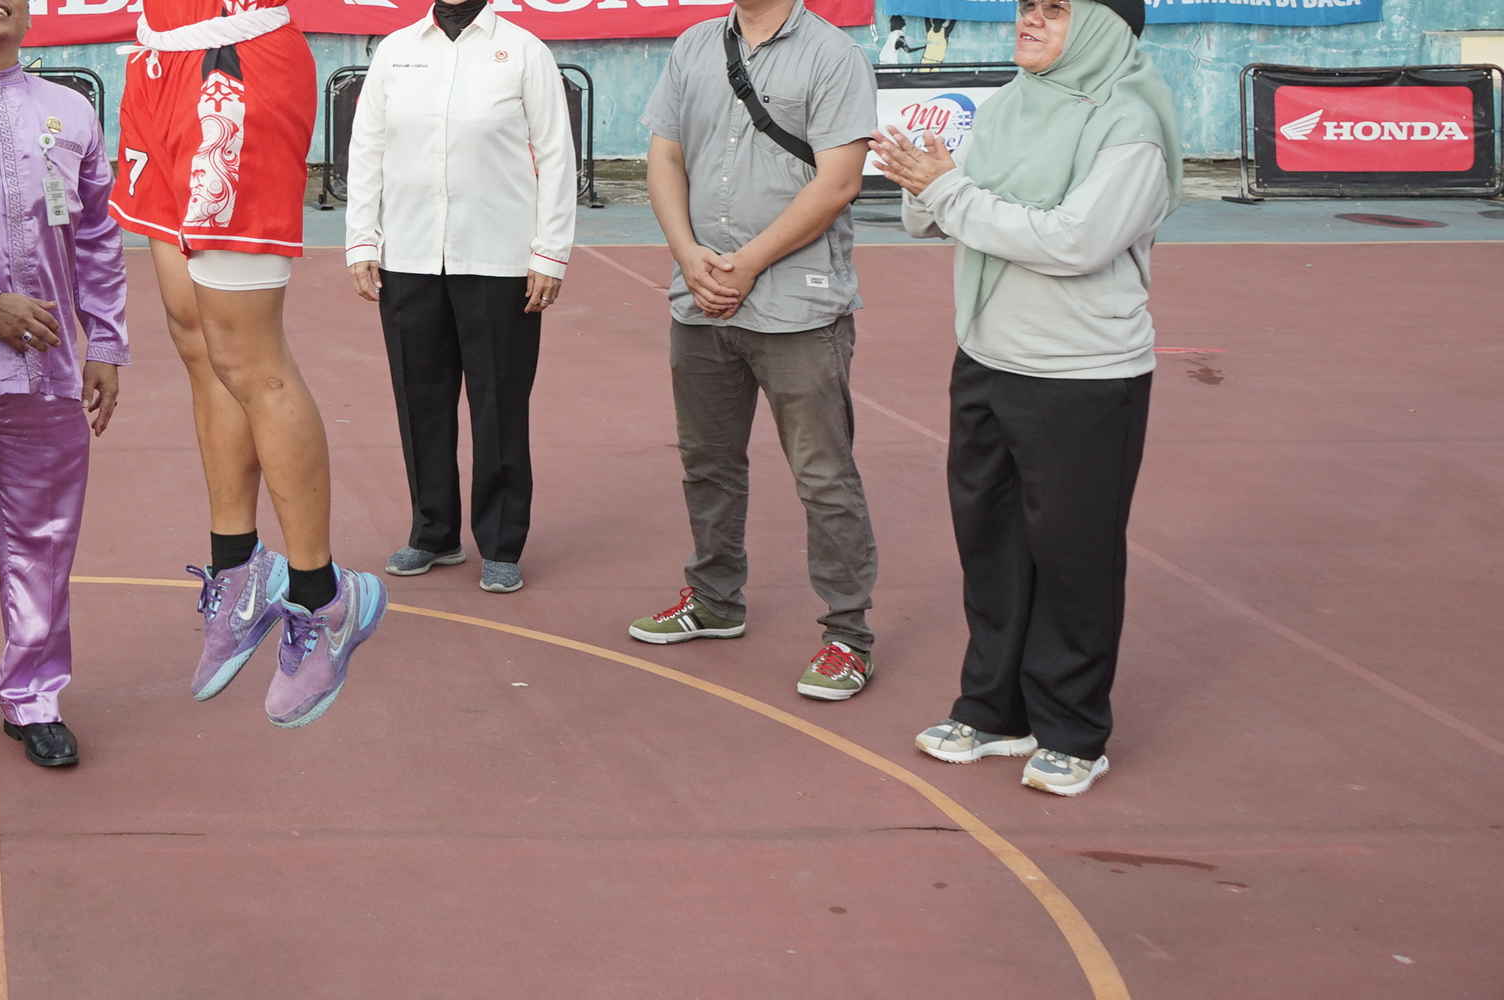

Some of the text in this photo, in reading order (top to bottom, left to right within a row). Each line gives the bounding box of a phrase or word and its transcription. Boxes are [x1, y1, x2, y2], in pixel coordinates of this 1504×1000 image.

[901, 103, 950, 136] My
[1323, 121, 1469, 141] HONDA
[125, 147, 150, 197] 7
